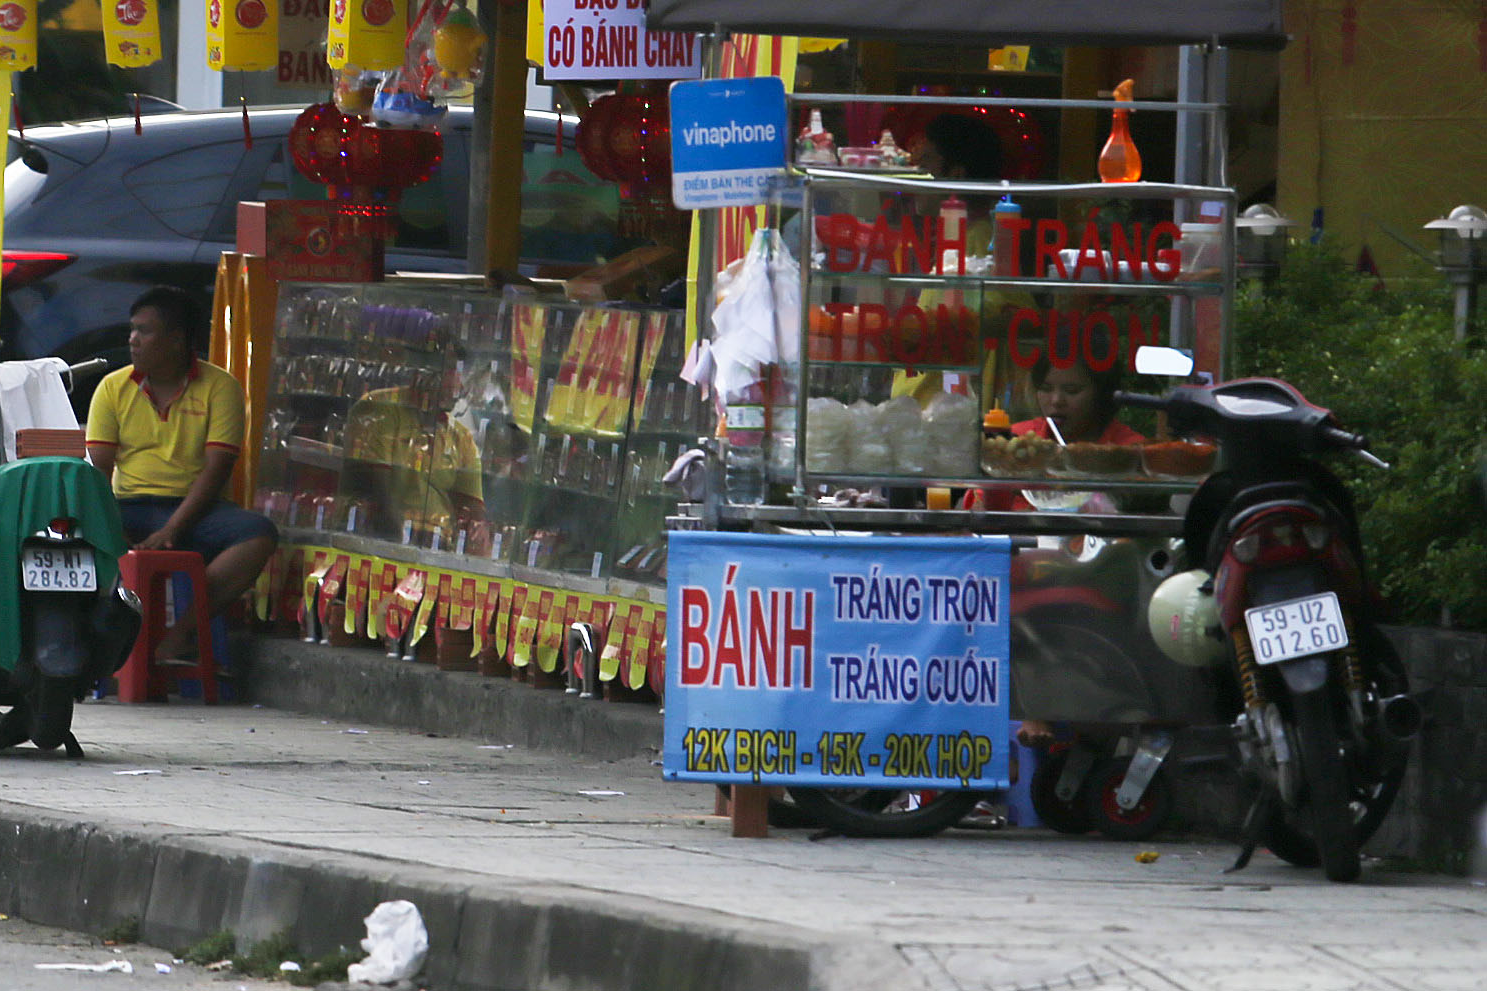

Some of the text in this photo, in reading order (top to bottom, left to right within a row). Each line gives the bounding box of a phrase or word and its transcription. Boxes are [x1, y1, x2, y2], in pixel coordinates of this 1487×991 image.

[548, 17, 575, 68] CÓ
[581, 19, 638, 68] BÁNH
[683, 120, 776, 148] vinaphone
[830, 200, 967, 276] BÁNH
[994, 206, 1182, 281] TRÁNG
[29, 570, 92, 589] 284.82
[680, 563, 815, 689] BÁNH
[833, 566, 921, 622] TRÁNG
[929, 574, 998, 634] TRỘN
[1259, 623, 1340, 659] 012.60
[1261, 600, 1327, 633] 59-U2
[830, 647, 998, 704] TRÁNG CUỐN
[684, 728, 730, 773] 12K
[735, 730, 796, 783] BỊCH
[818, 732, 865, 776] 15K
[884, 733, 931, 778] 20K
[937, 730, 992, 787] HỘP
